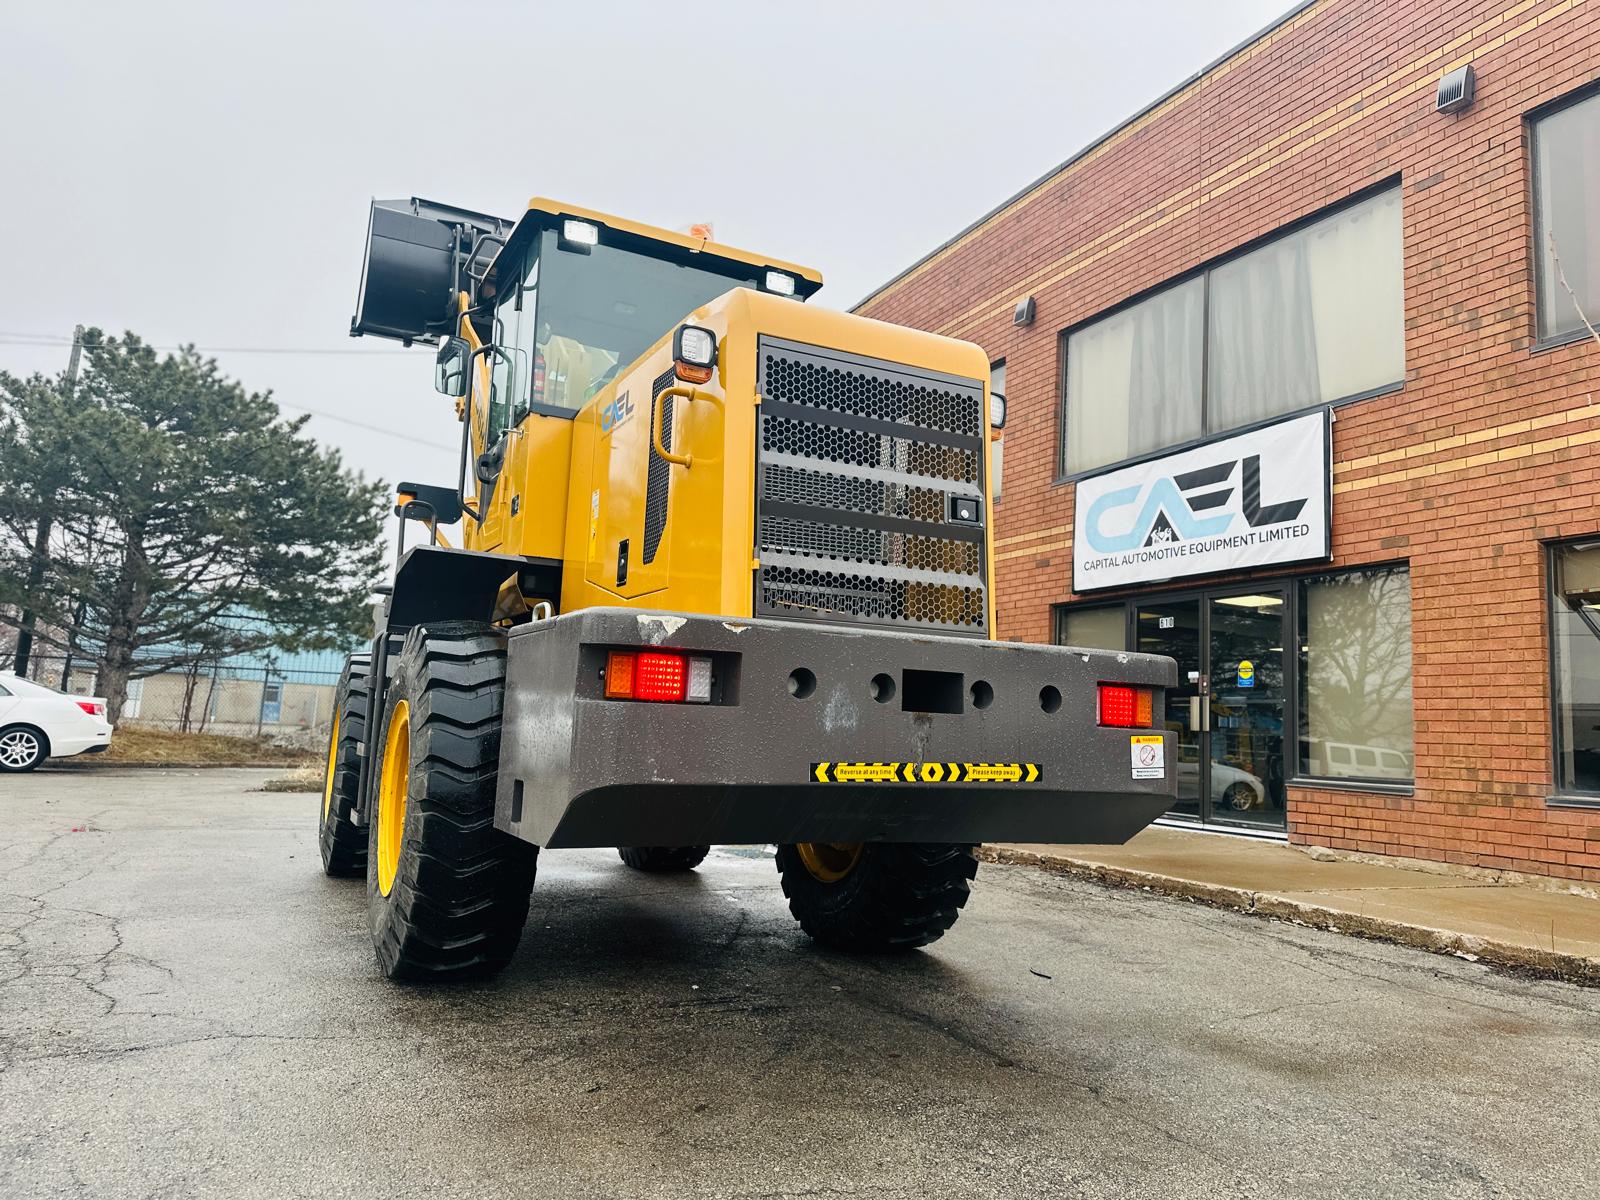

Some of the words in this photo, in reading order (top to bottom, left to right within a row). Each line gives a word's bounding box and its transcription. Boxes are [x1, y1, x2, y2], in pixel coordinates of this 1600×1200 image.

[1085, 454, 1308, 553] CAEL
[1084, 556, 1120, 571] CAPITAL
[1121, 545, 1187, 565] AUTOMOTIVE
[1189, 532, 1256, 555] EQUIPMENT
[1258, 524, 1310, 543] LIMITED
